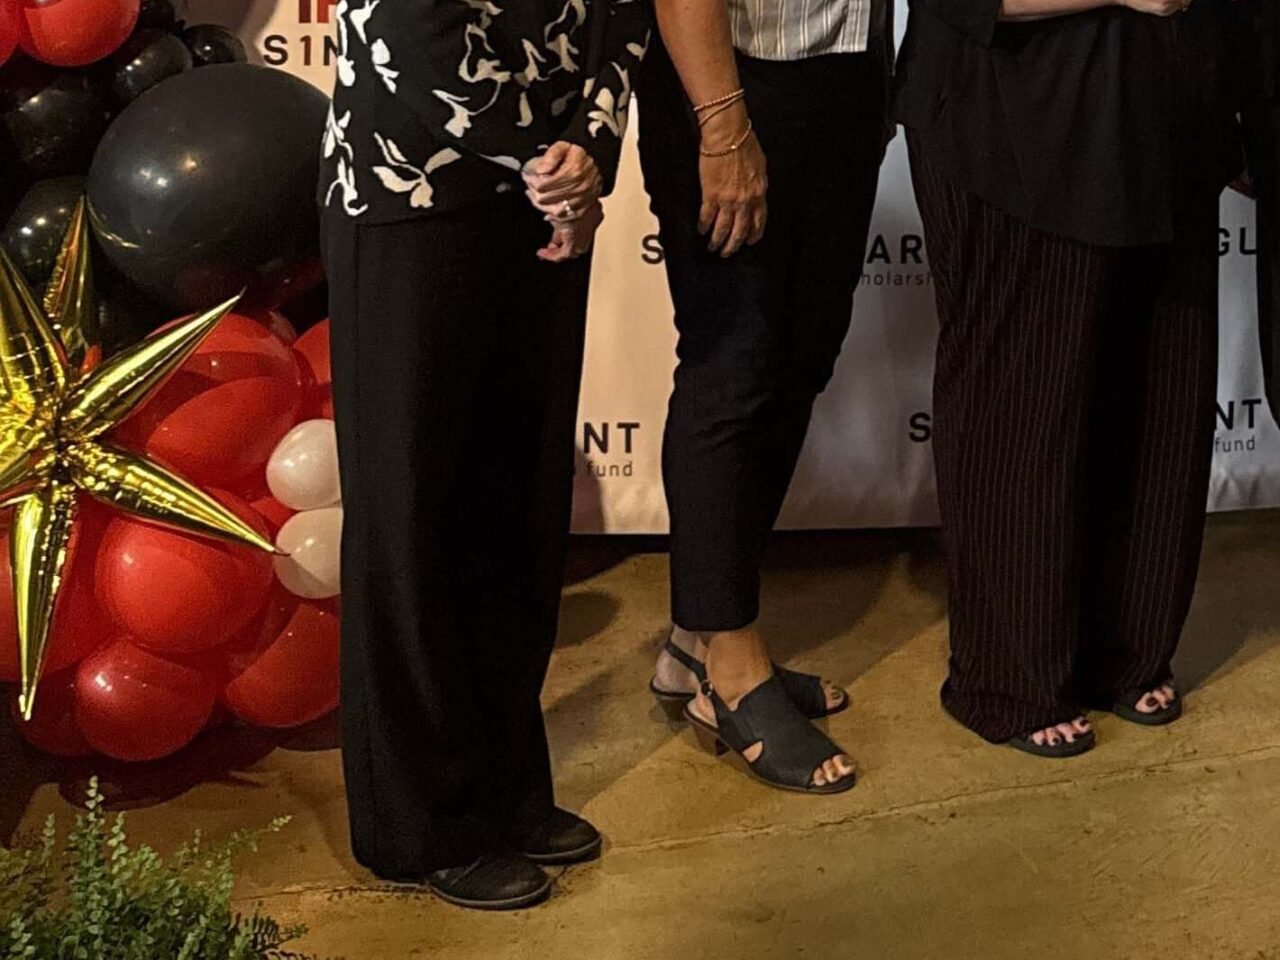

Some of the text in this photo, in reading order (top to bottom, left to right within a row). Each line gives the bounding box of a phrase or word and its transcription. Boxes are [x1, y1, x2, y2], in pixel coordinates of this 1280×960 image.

[263, 34, 338, 66] S1N
[1215, 435, 1255, 453] fund
[587, 460, 633, 477] fund
